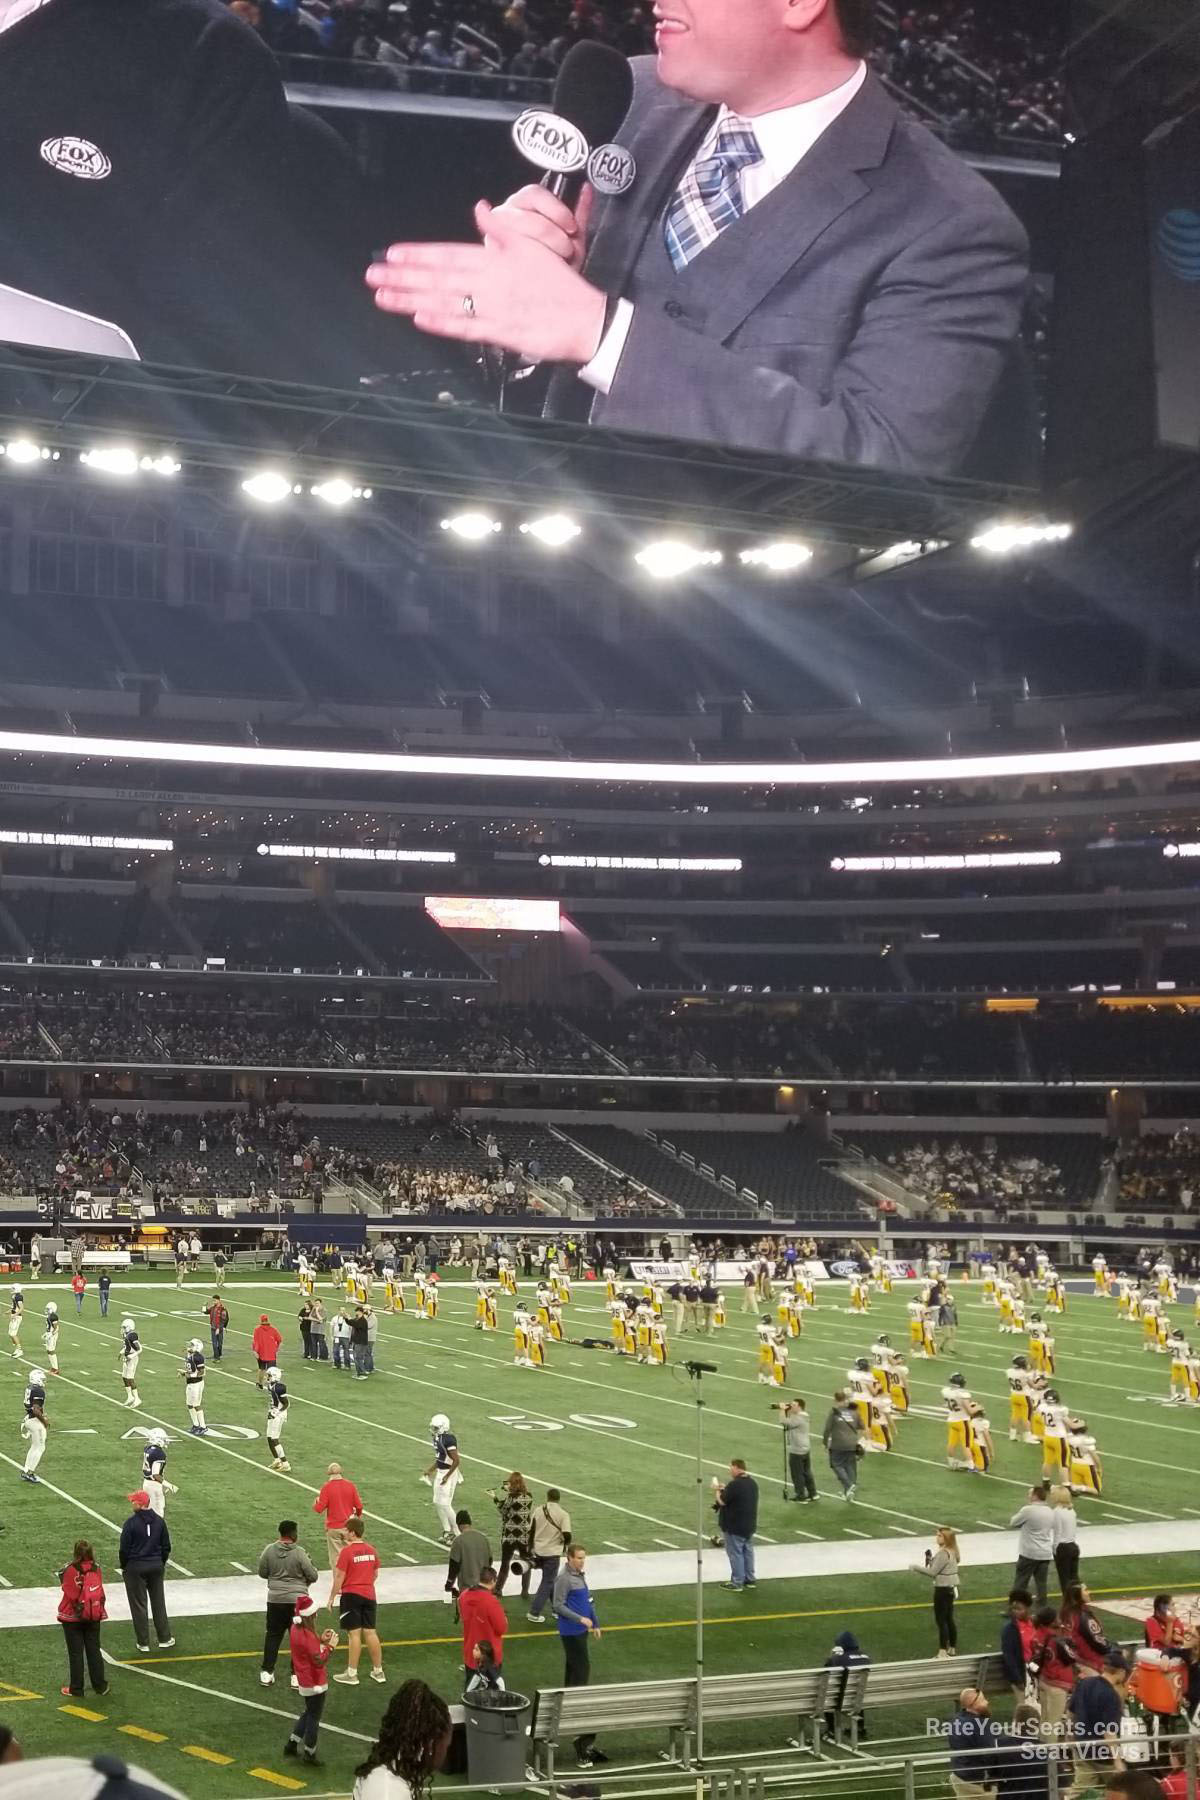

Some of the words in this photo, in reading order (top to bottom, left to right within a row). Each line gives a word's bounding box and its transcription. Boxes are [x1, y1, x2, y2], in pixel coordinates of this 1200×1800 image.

[530, 119, 574, 154] FOX
[58, 140, 99, 166] FOX
[525, 138, 569, 165] SPORTS
[598, 152, 630, 179] FOX
[487, 1413, 638, 1431] 50
